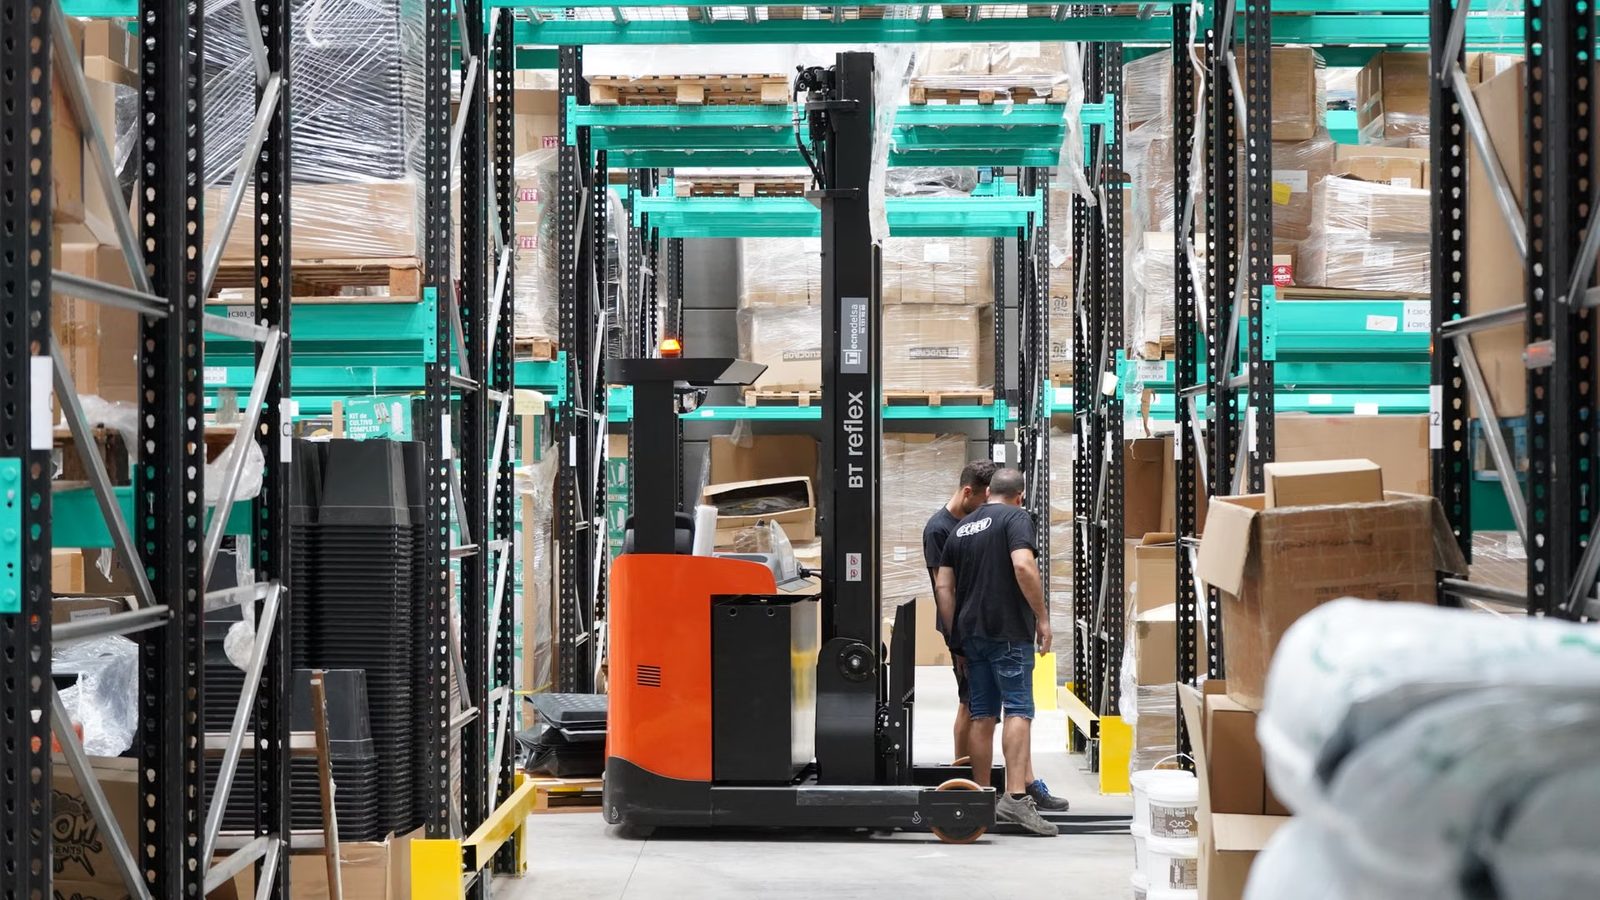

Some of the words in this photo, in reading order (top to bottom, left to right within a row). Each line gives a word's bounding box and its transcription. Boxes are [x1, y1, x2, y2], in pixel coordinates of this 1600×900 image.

[349, 425, 380, 433] COMPLETO
[843, 391, 864, 456] reflex
[848, 463, 864, 488] BT
